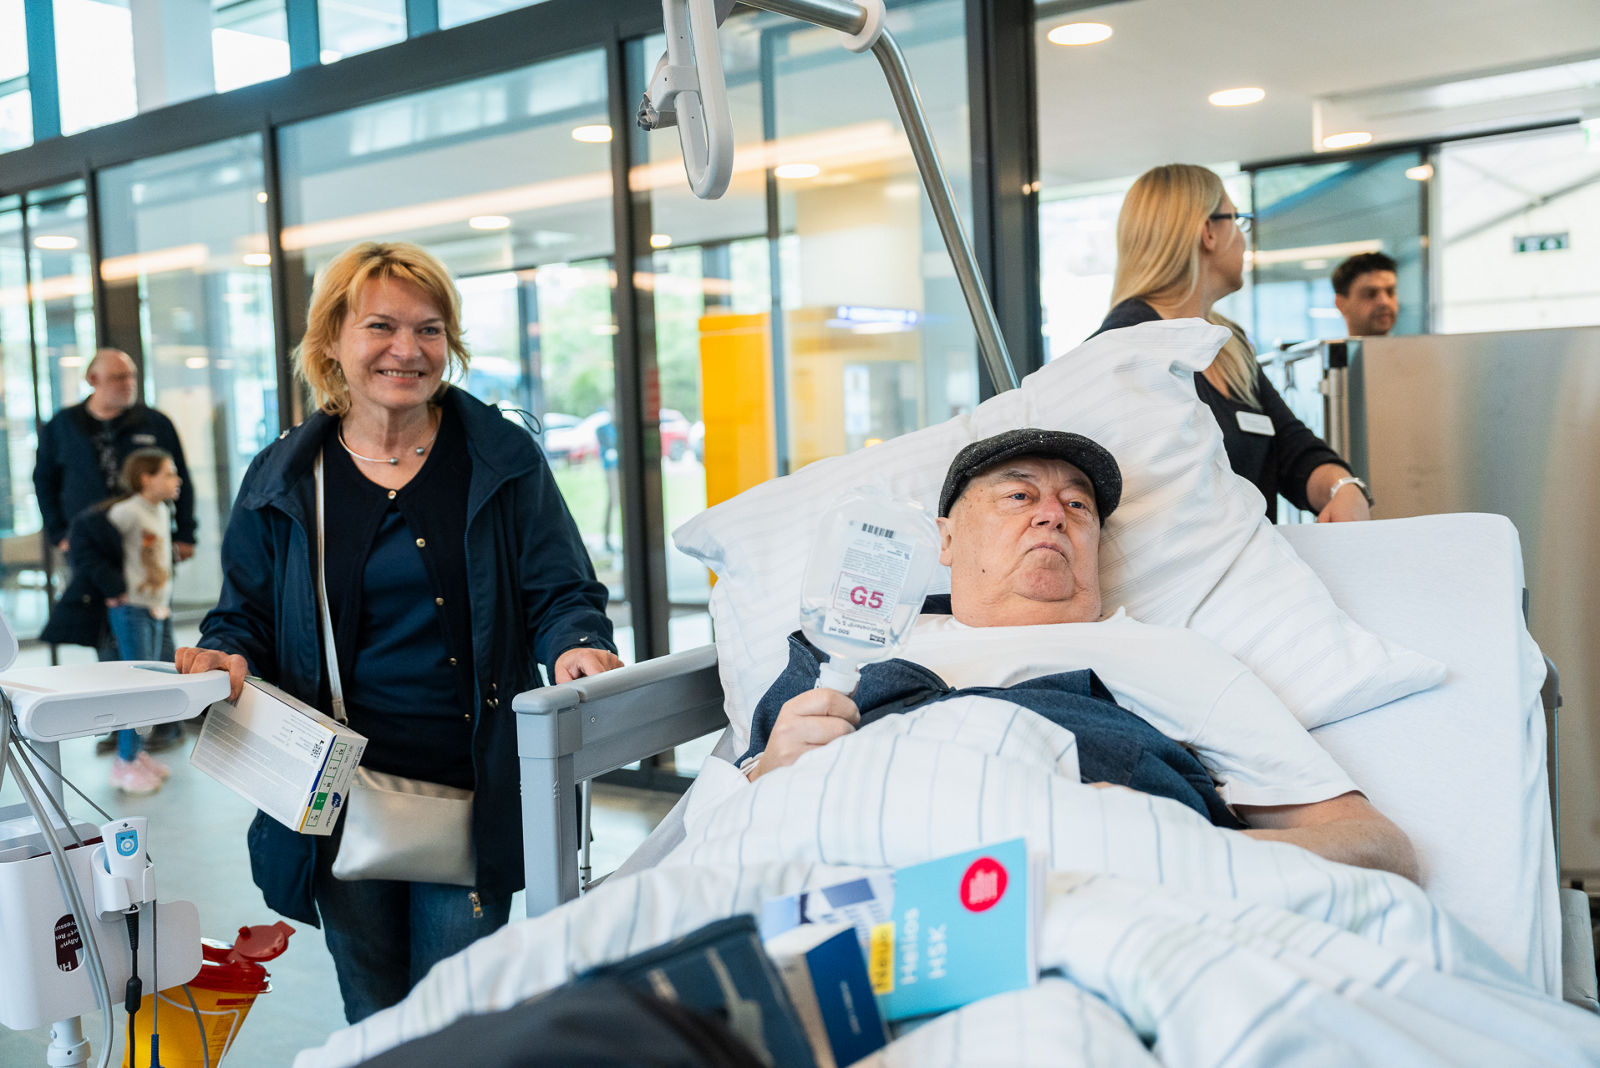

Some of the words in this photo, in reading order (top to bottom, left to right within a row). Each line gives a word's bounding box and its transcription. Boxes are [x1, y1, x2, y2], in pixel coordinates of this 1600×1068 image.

[850, 586, 884, 608] G5
[901, 908, 919, 985] Helios
[928, 924, 947, 978] HSK
